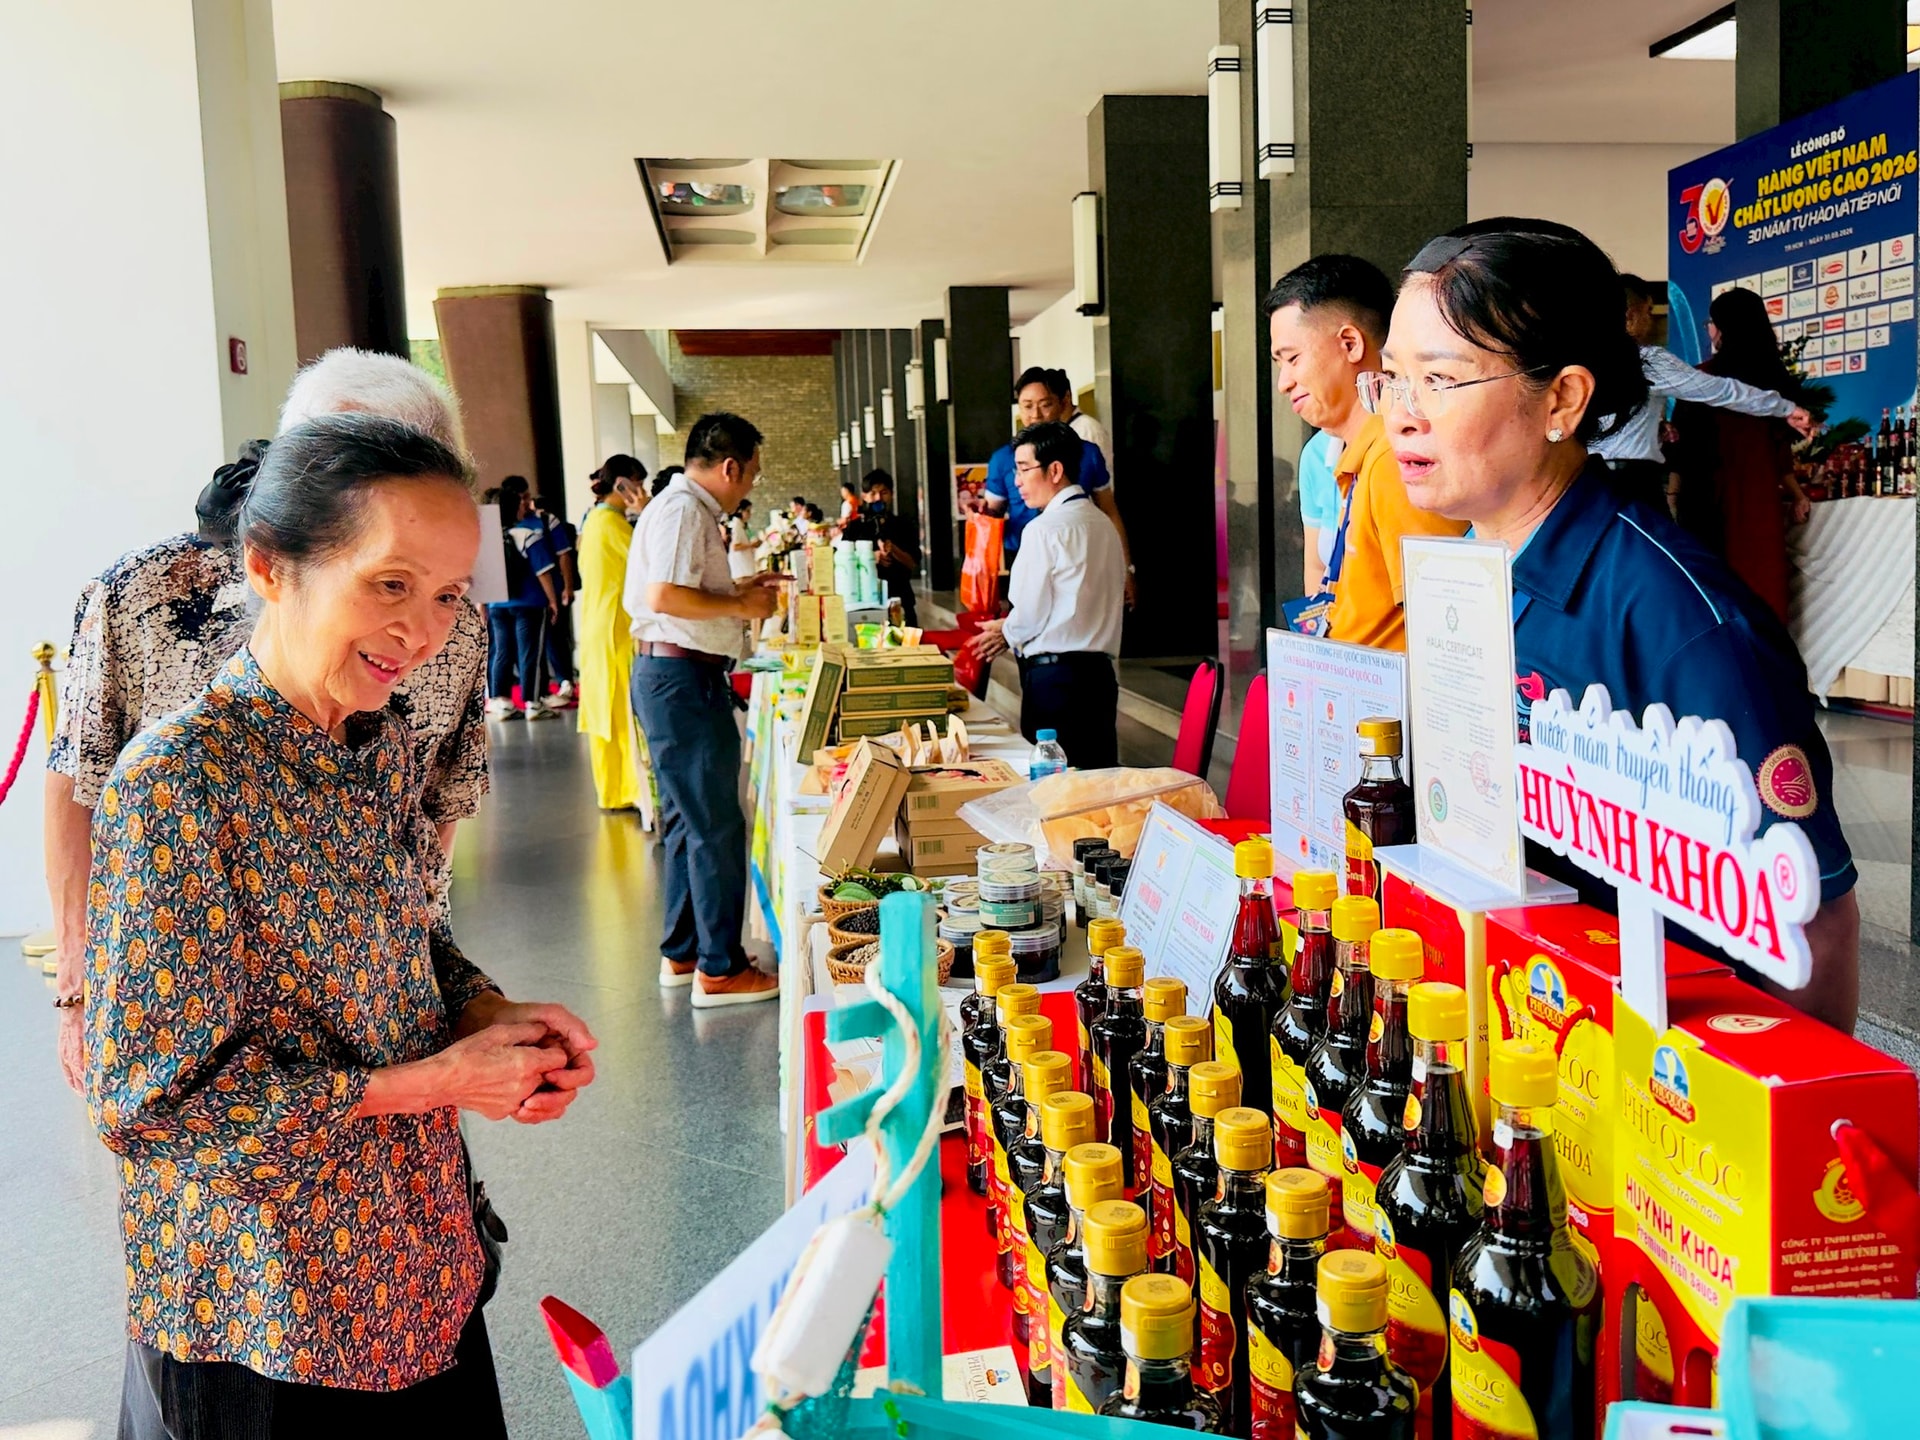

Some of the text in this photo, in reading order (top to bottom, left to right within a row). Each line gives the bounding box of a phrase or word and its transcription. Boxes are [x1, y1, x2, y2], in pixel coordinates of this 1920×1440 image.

[1733, 198, 1773, 229] CHẤT
[1773, 179, 1832, 217] LƯỢNG
[1832, 167, 1869, 197] CAO
[1870, 150, 1918, 186] 2026
[1758, 133, 1888, 198] HÀNG VIỆT NAM
[1761, 218, 1792, 241] NĂM
[1791, 213, 1810, 232] TỰ
[1808, 204, 1836, 227] HÀO
[1834, 198, 1851, 218] VÀ
[1849, 191, 1877, 214] TIẾP
[1446, 640, 1483, 659] CERTIFICATE
[1573, 706, 1609, 771] mắm
[1616, 731, 1672, 810] truyền
[1679, 744, 1738, 845] thống
[1518, 763, 1642, 883] HUỲNH
[1622, 1089, 1658, 1144] PHÚ
[1660, 1123, 1742, 1203] QUỐC
[1625, 1172, 1673, 1243] HUỲNH
[1781, 1238, 1808, 1248] CÔNG
[1811, 1237, 1821, 1246] TY
[1781, 1250, 1811, 1265] NƯỚC
[1813, 1246, 1839, 1262] MẮM
[1840, 1245, 1878, 1260] HUỲNH
